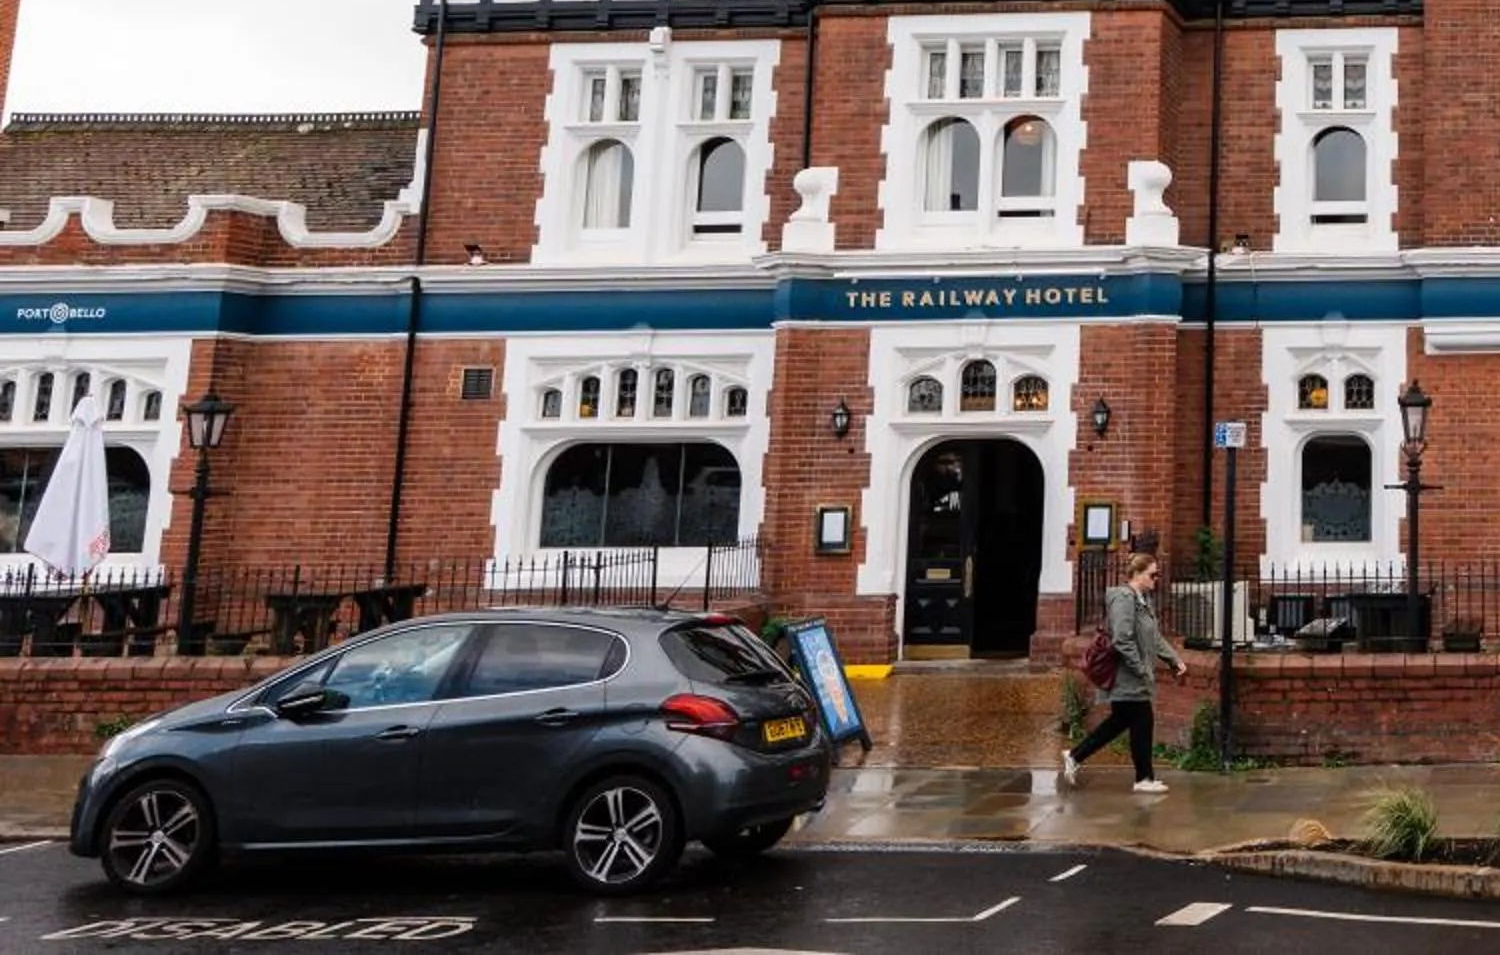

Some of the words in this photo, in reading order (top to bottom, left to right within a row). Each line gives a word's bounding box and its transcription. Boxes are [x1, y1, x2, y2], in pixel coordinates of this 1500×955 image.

[846, 292, 892, 308] THE
[901, 289, 1018, 308] RAILWAY
[1025, 287, 1109, 305] HOTEL
[38, 916, 478, 940] DISABLED
